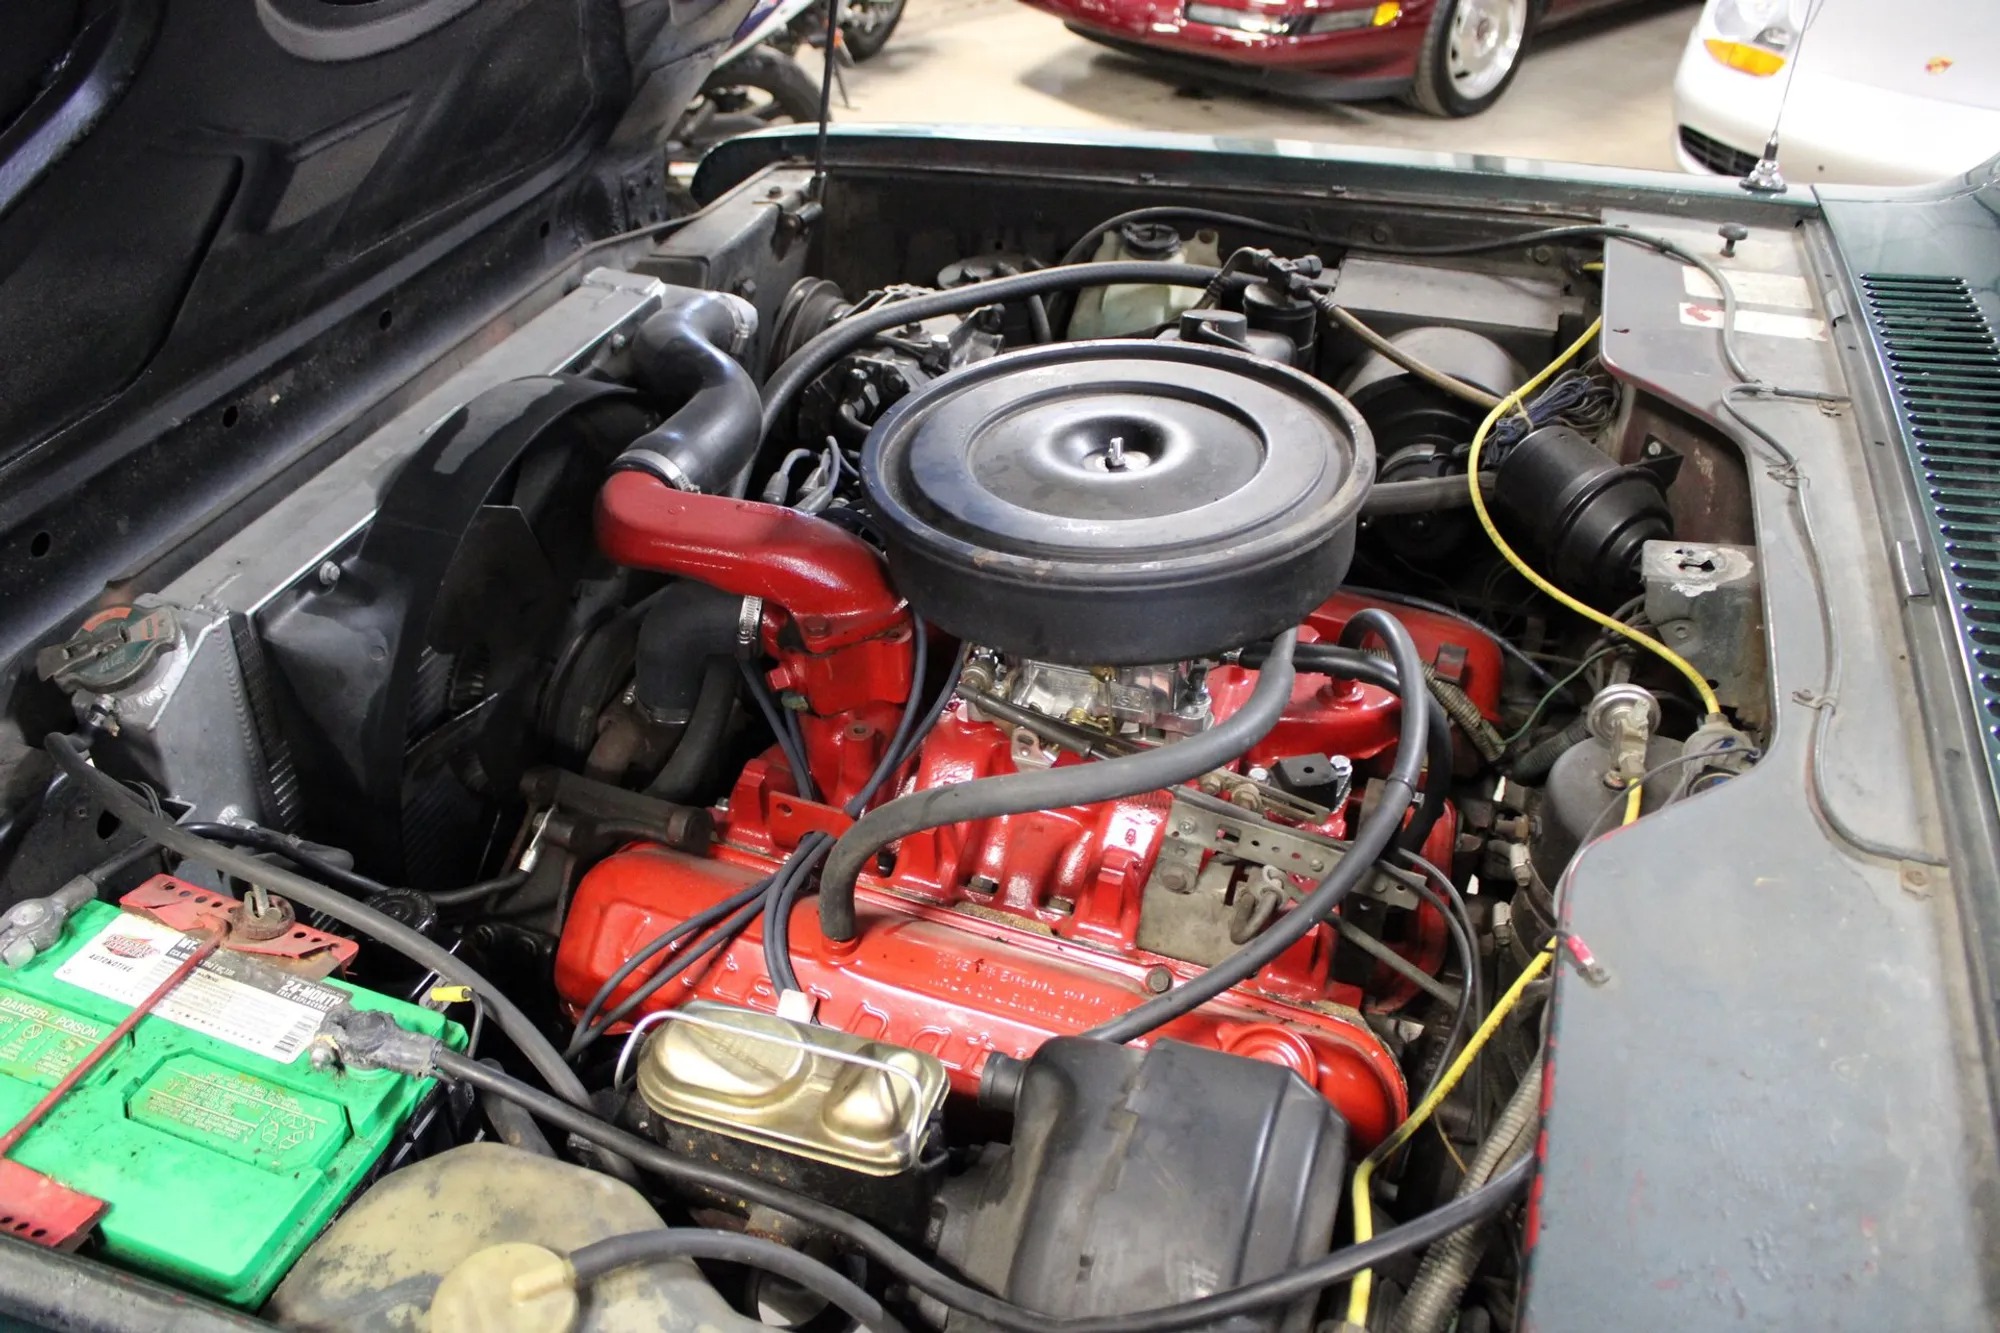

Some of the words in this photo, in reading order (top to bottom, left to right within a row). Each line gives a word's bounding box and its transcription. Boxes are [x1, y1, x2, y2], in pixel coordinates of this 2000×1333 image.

[88, 953, 134, 973] AUTOMOTIVE
[1, 997, 48, 1020] DANGER
[55, 1016, 99, 1038] POISON
